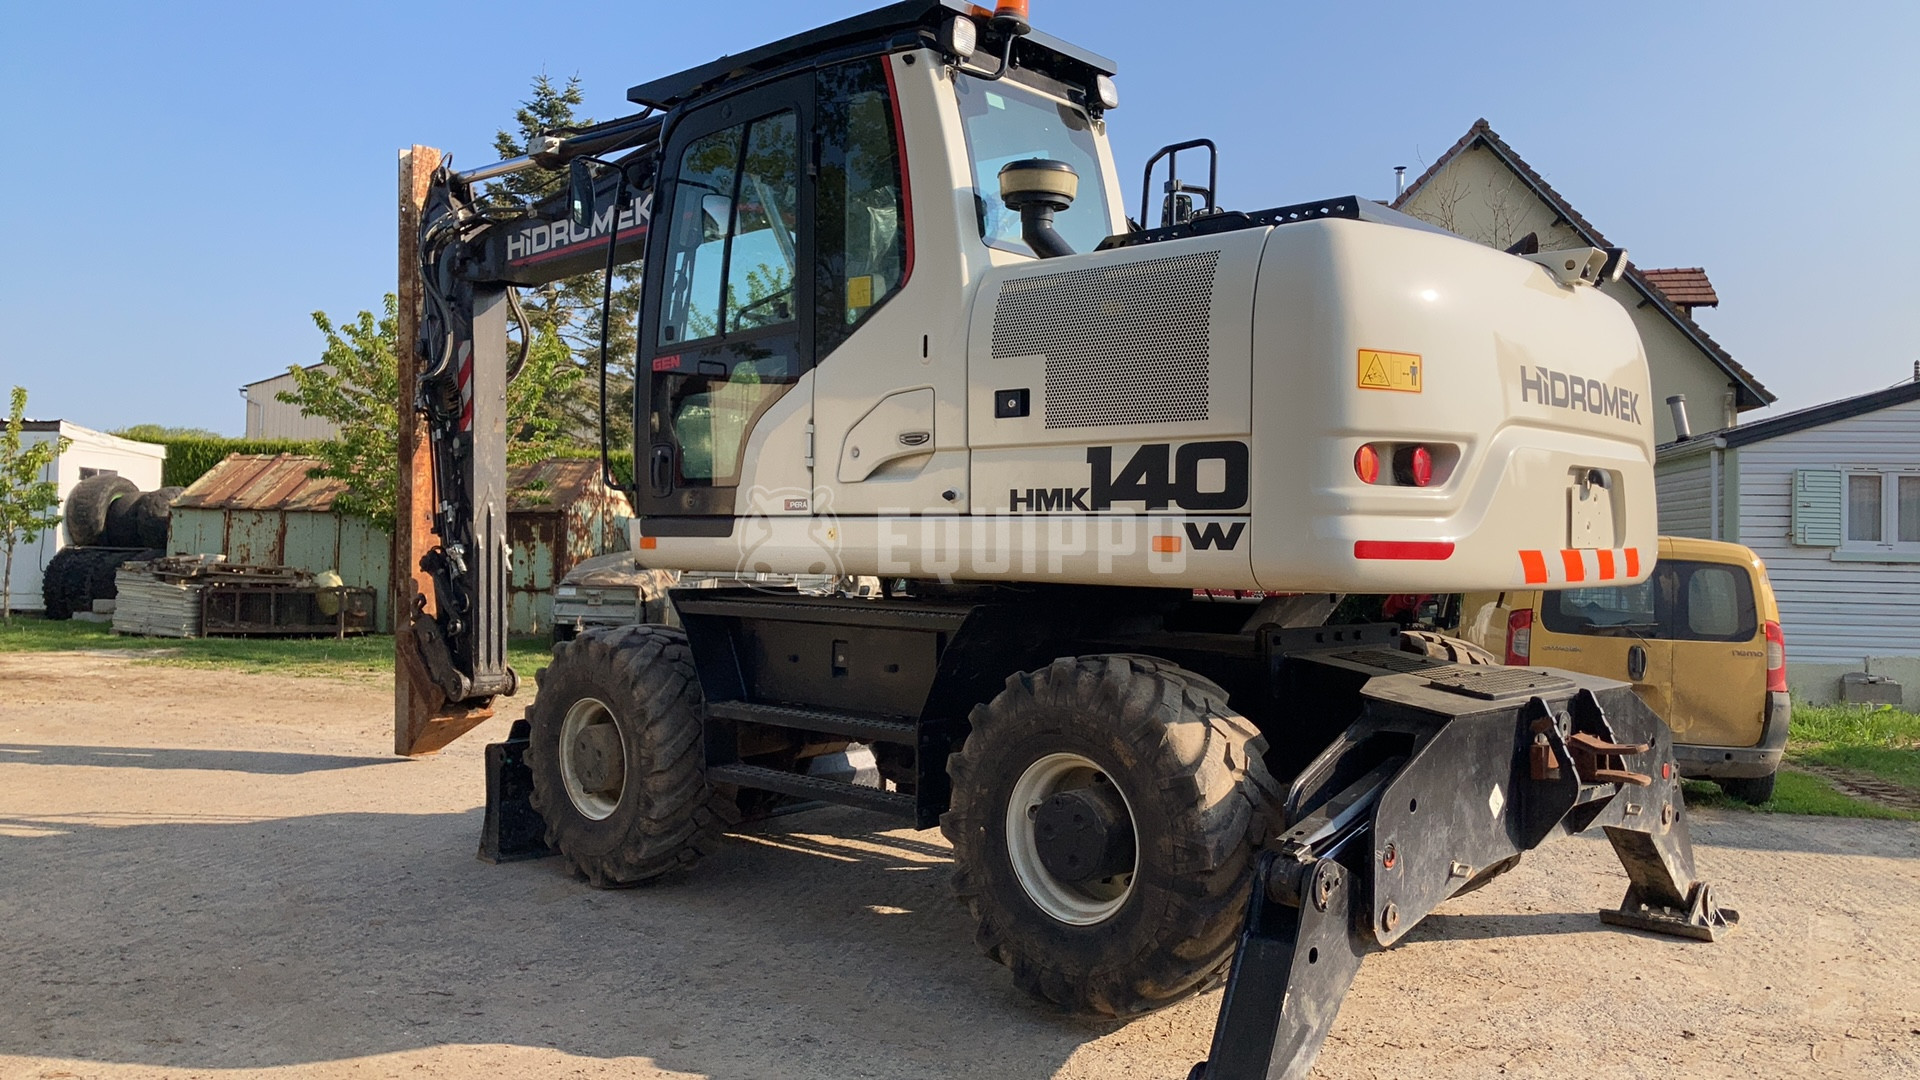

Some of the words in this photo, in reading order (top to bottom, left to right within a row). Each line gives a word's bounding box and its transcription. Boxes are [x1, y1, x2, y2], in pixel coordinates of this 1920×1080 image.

[653, 354, 681, 372] GEN
[1010, 487, 1090, 512] HMK
[1086, 440, 1250, 512] 140
[1182, 522, 1247, 551] W
